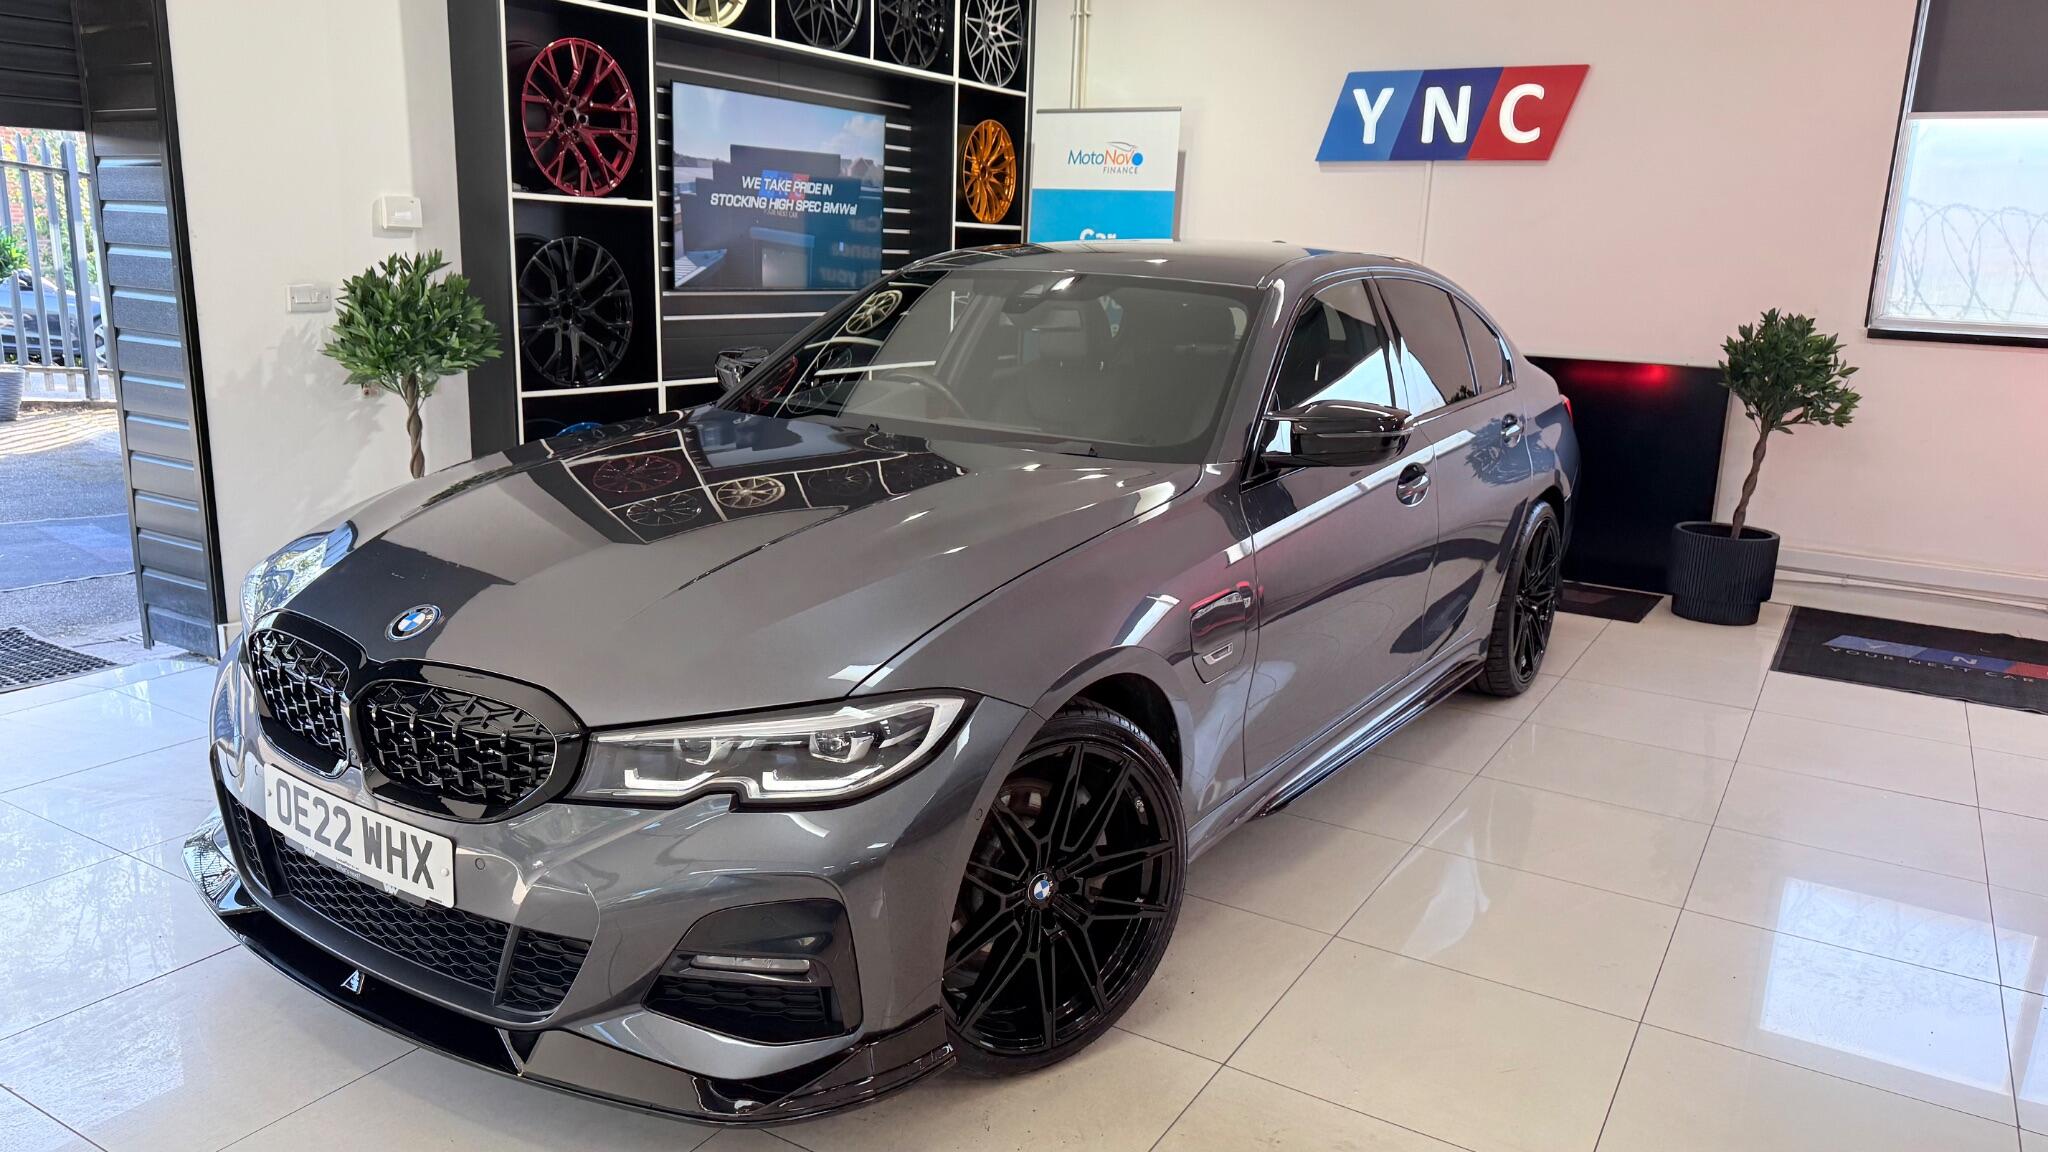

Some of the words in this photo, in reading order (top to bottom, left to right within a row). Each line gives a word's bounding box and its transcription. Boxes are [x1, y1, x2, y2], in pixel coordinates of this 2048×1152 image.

[1103, 166, 1139, 175] FINANCE
[741, 176, 762, 190] WE
[763, 178, 793, 193] TAKE
[793, 181, 822, 195] PRIDE
[822, 183, 834, 196] IN
[710, 193, 767, 209] STOCKING
[768, 198, 795, 211] HIGH
[795, 199, 822, 213] SPEC
[275, 777, 353, 858] OE22
[361, 815, 435, 891] WHX
